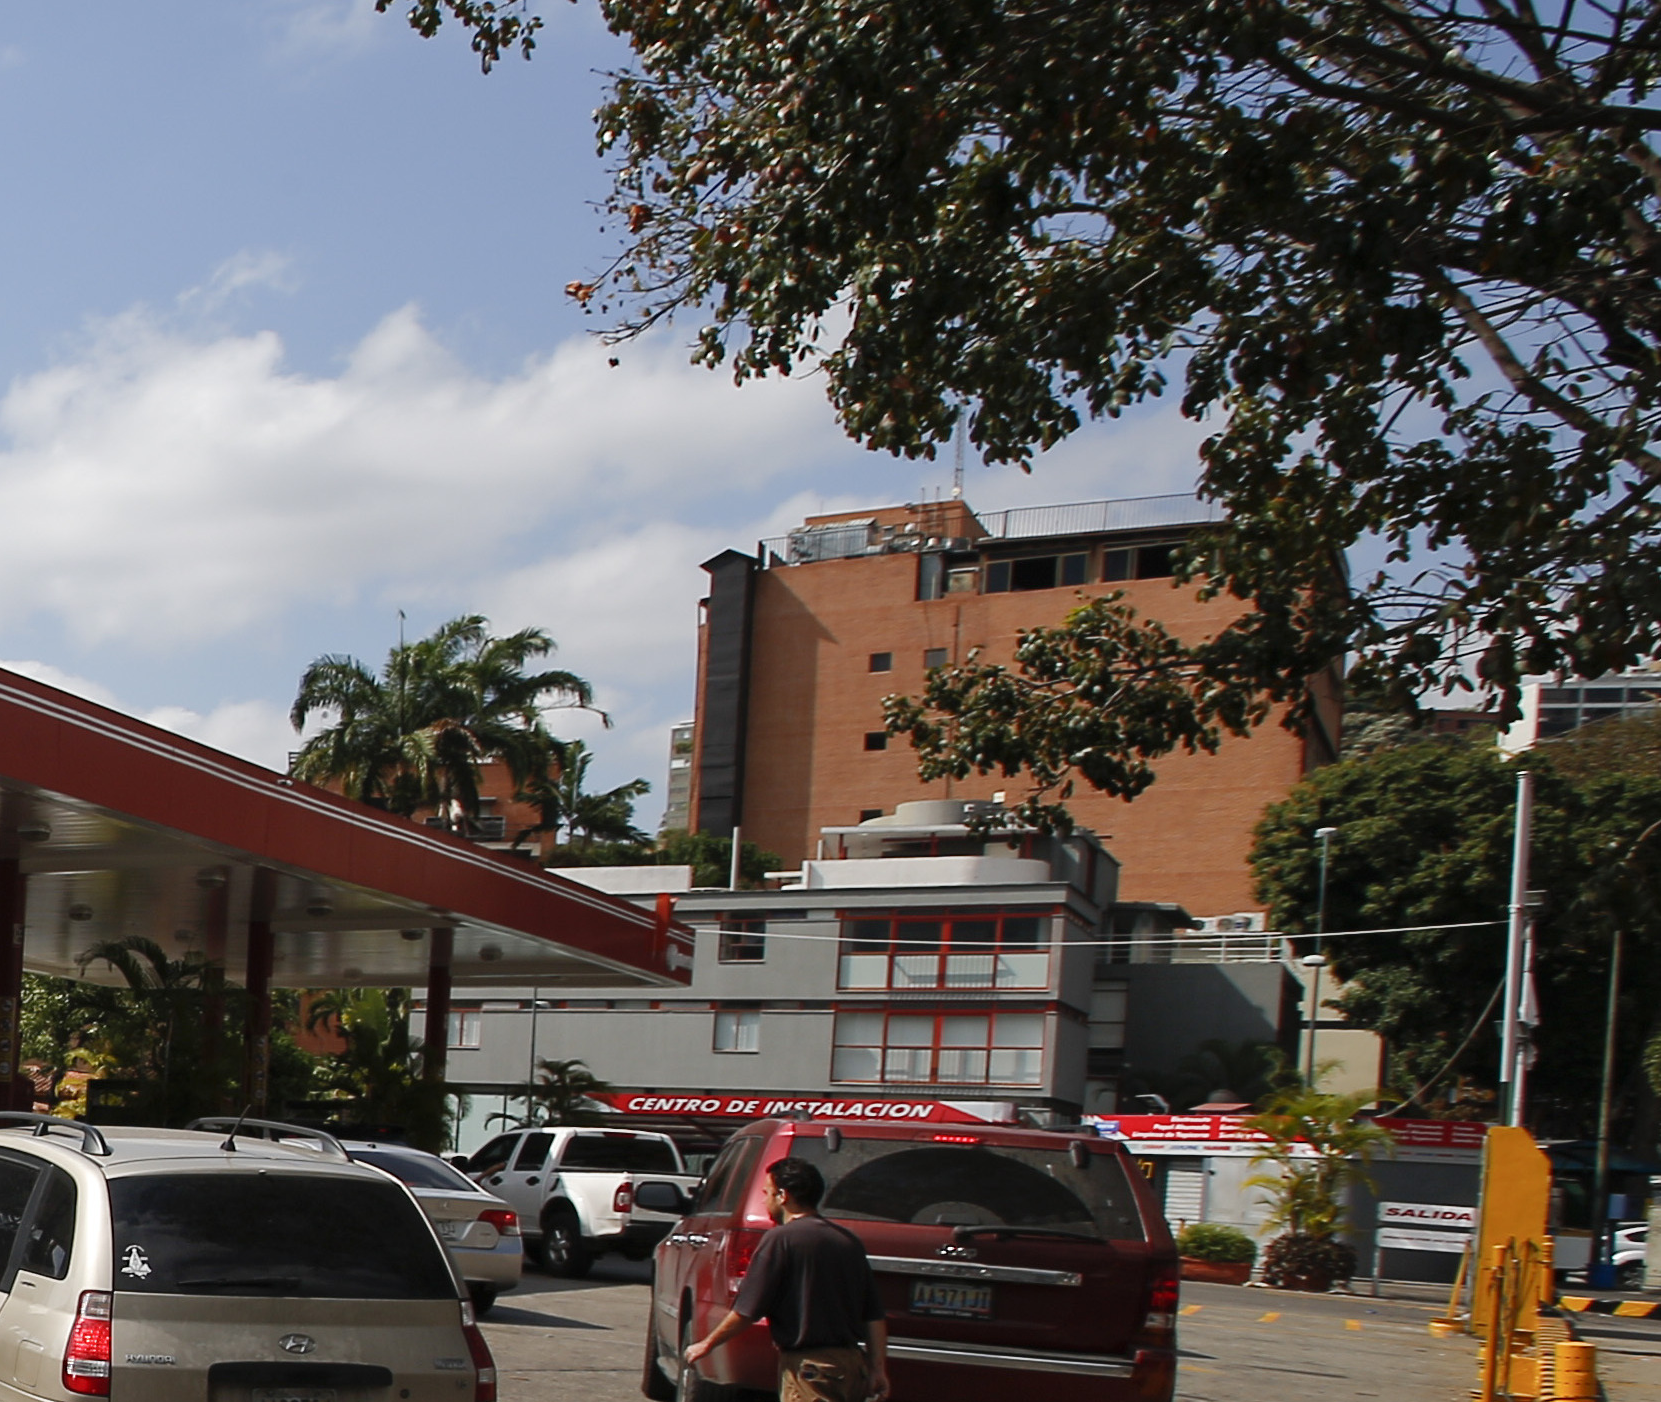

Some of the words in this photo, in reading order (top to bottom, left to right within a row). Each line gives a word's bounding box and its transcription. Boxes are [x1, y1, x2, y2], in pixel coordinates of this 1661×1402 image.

[628, 1097, 720, 1113] CENTRO
[725, 1099, 757, 1114] DE
[762, 1101, 934, 1119] INSTALACION
[1385, 1208, 1472, 1220] SALIDA
